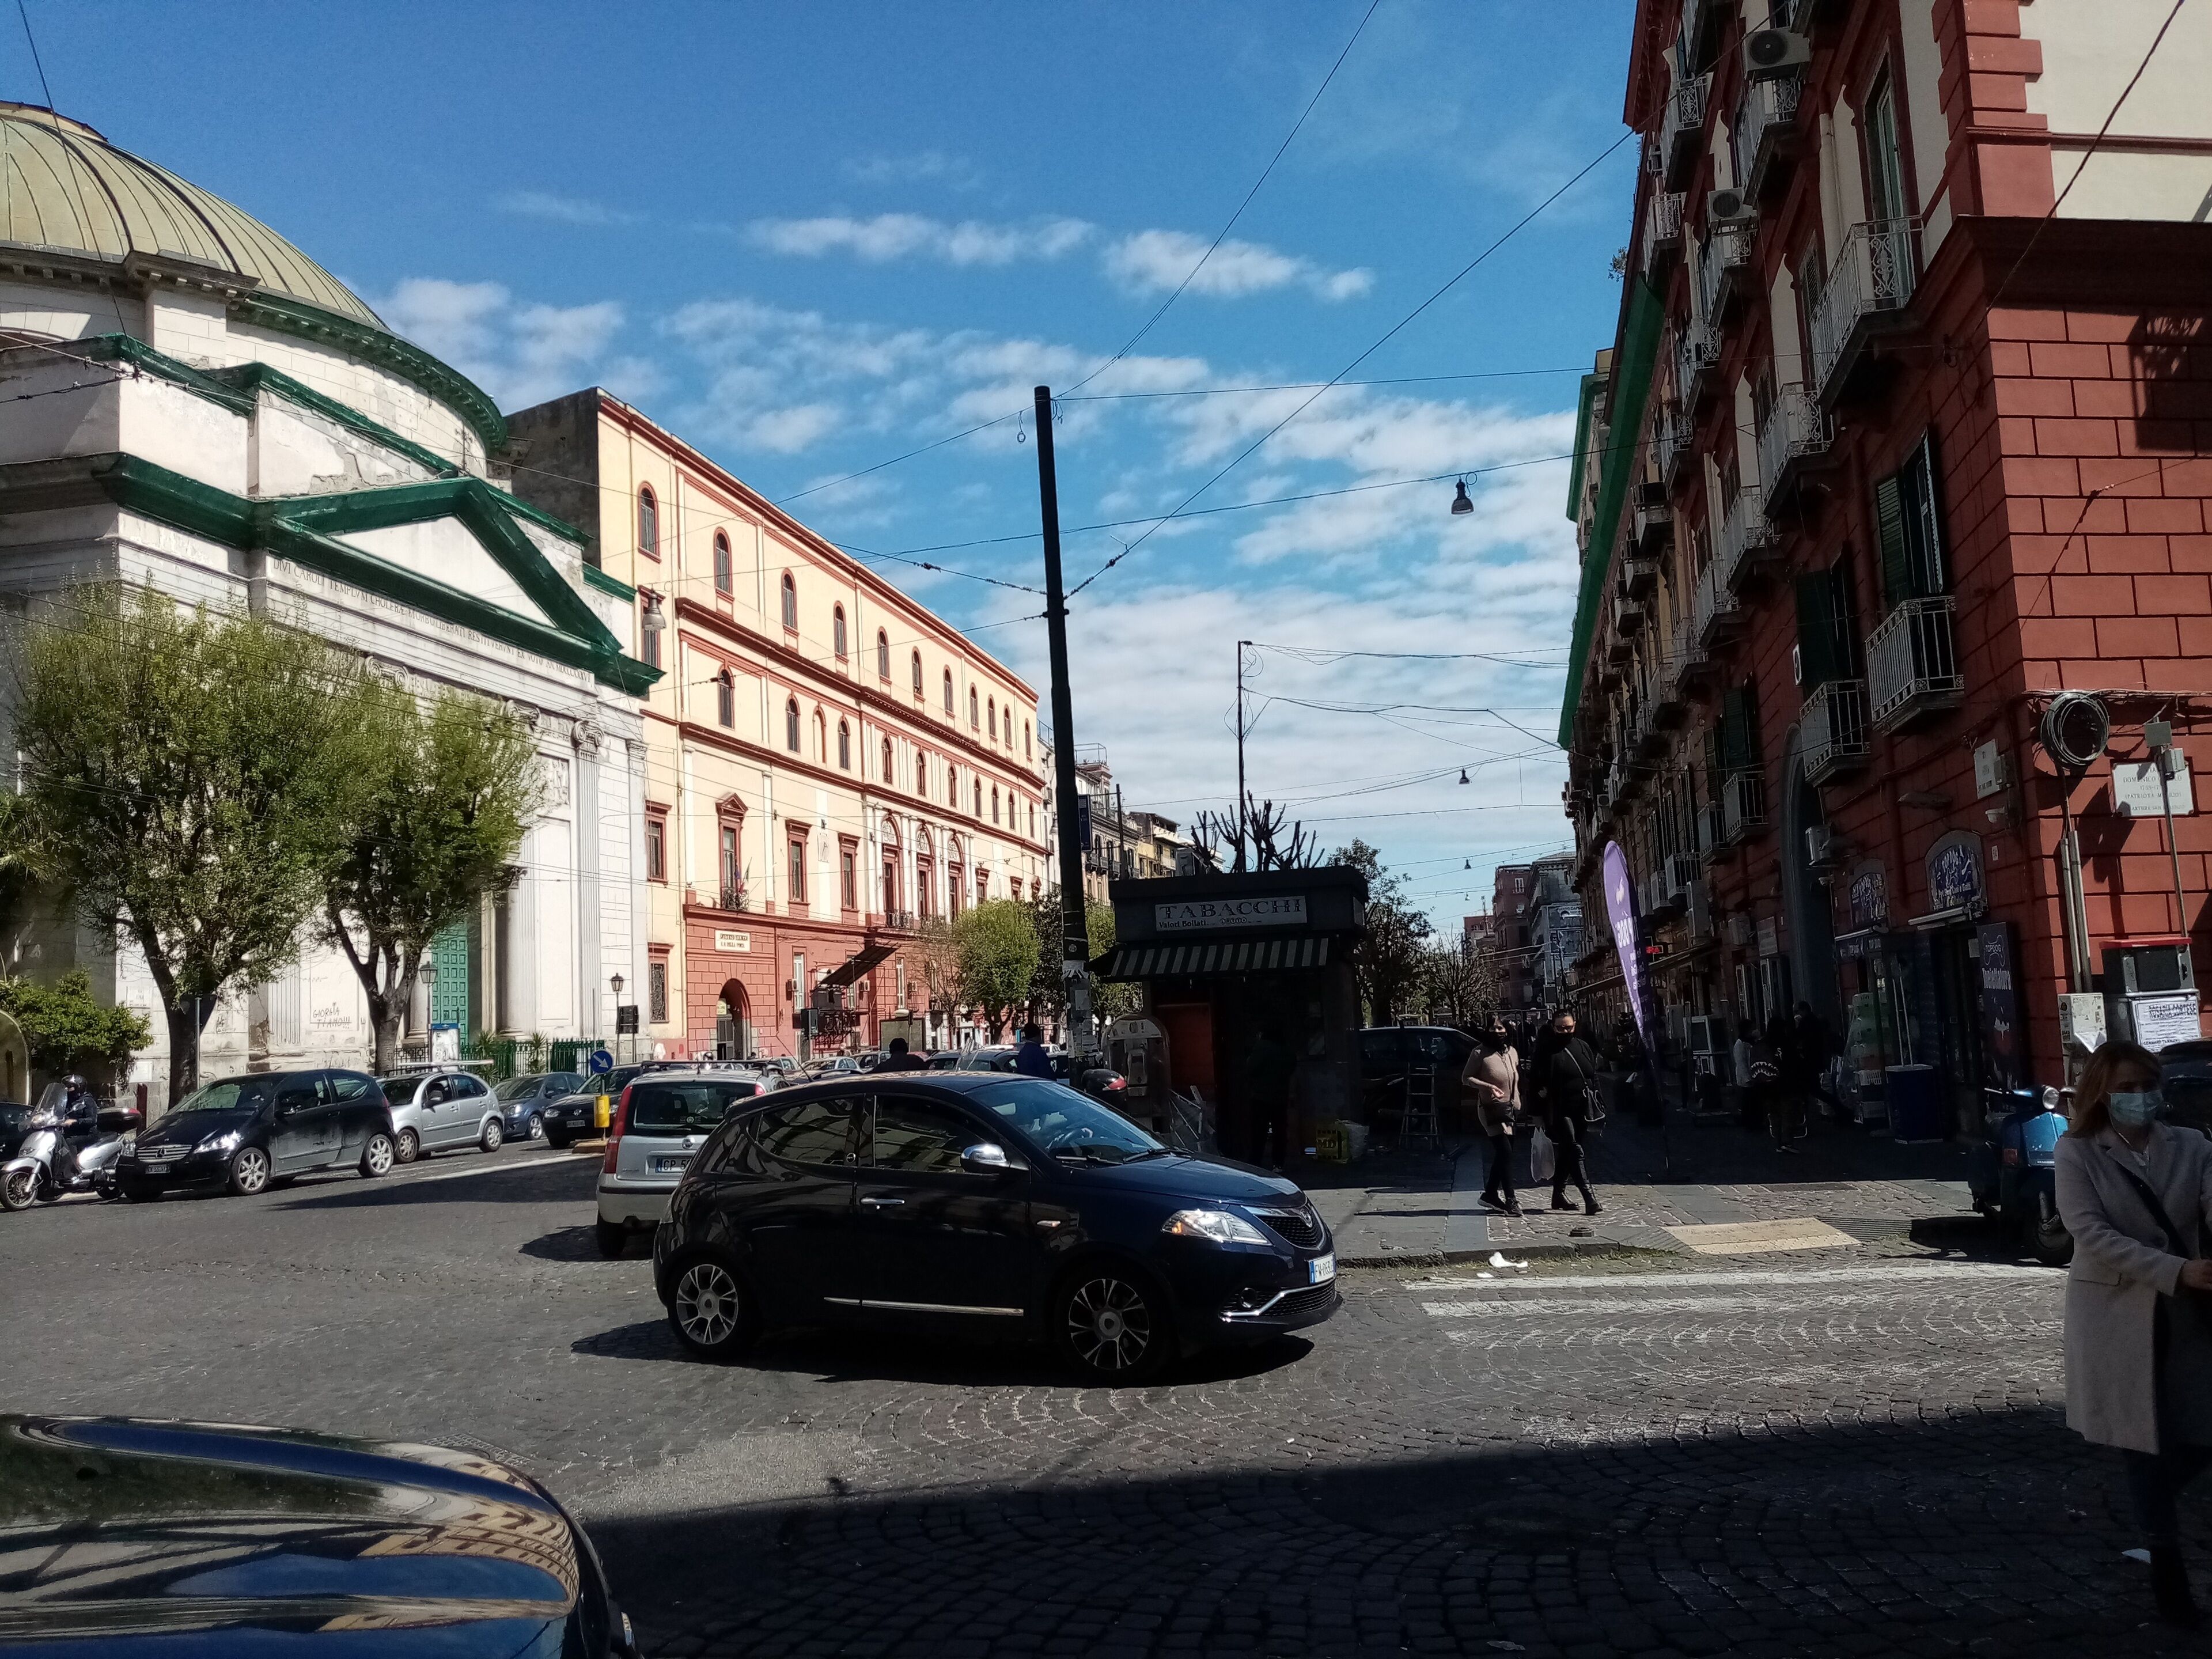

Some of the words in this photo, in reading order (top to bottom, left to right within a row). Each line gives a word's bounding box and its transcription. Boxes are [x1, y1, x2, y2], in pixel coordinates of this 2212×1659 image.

[1159, 899, 1301, 919] TABACCHI
[313, 1002, 339, 1018] GIORGIA
[1317, 1138, 1337, 1149] MD
[663, 1160, 676, 1171] CP
